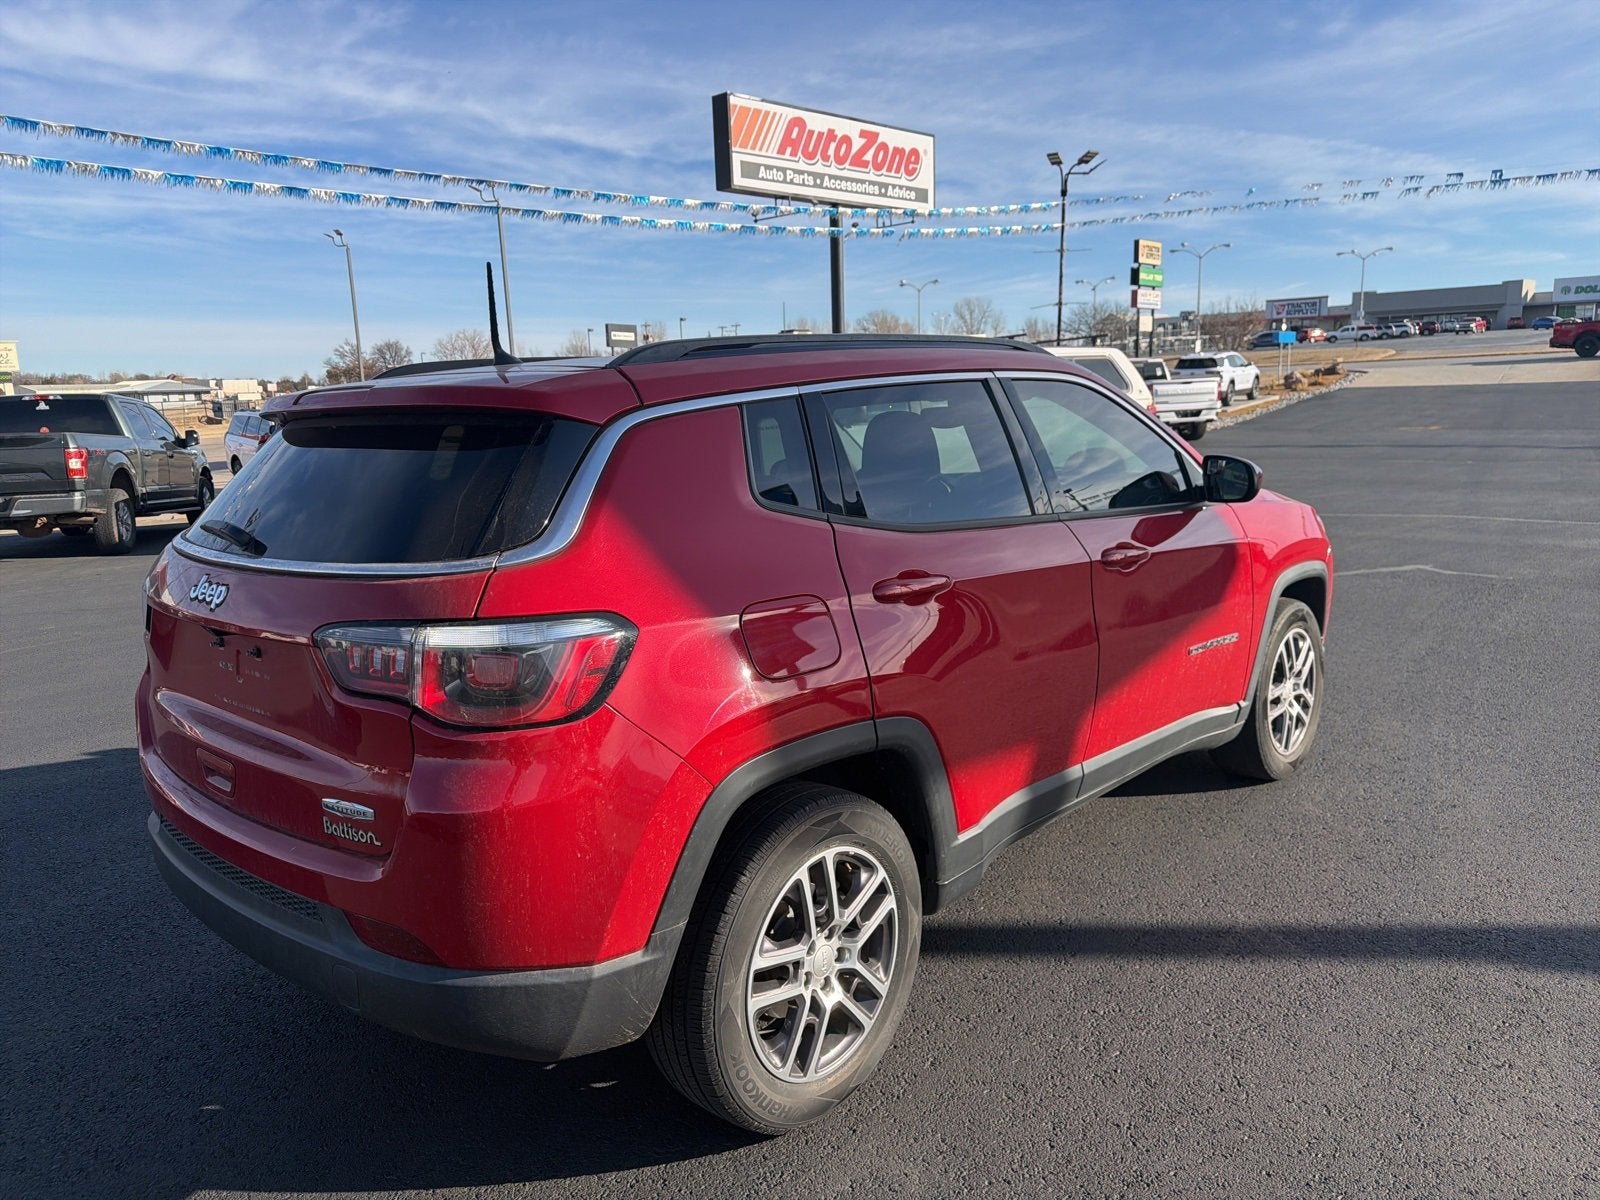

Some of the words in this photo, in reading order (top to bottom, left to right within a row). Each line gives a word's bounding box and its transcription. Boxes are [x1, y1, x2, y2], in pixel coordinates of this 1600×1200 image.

[776, 116, 922, 179] AutoZone
[758, 166, 784, 181] Auto
[786, 170, 814, 186] Parts
[823, 176, 880, 195] Accessories
[887, 185, 916, 200] Advice
[1286, 301, 1317, 310] TRACTOR
[190, 574, 228, 610] Jeep
[323, 816, 381, 845] Battison
